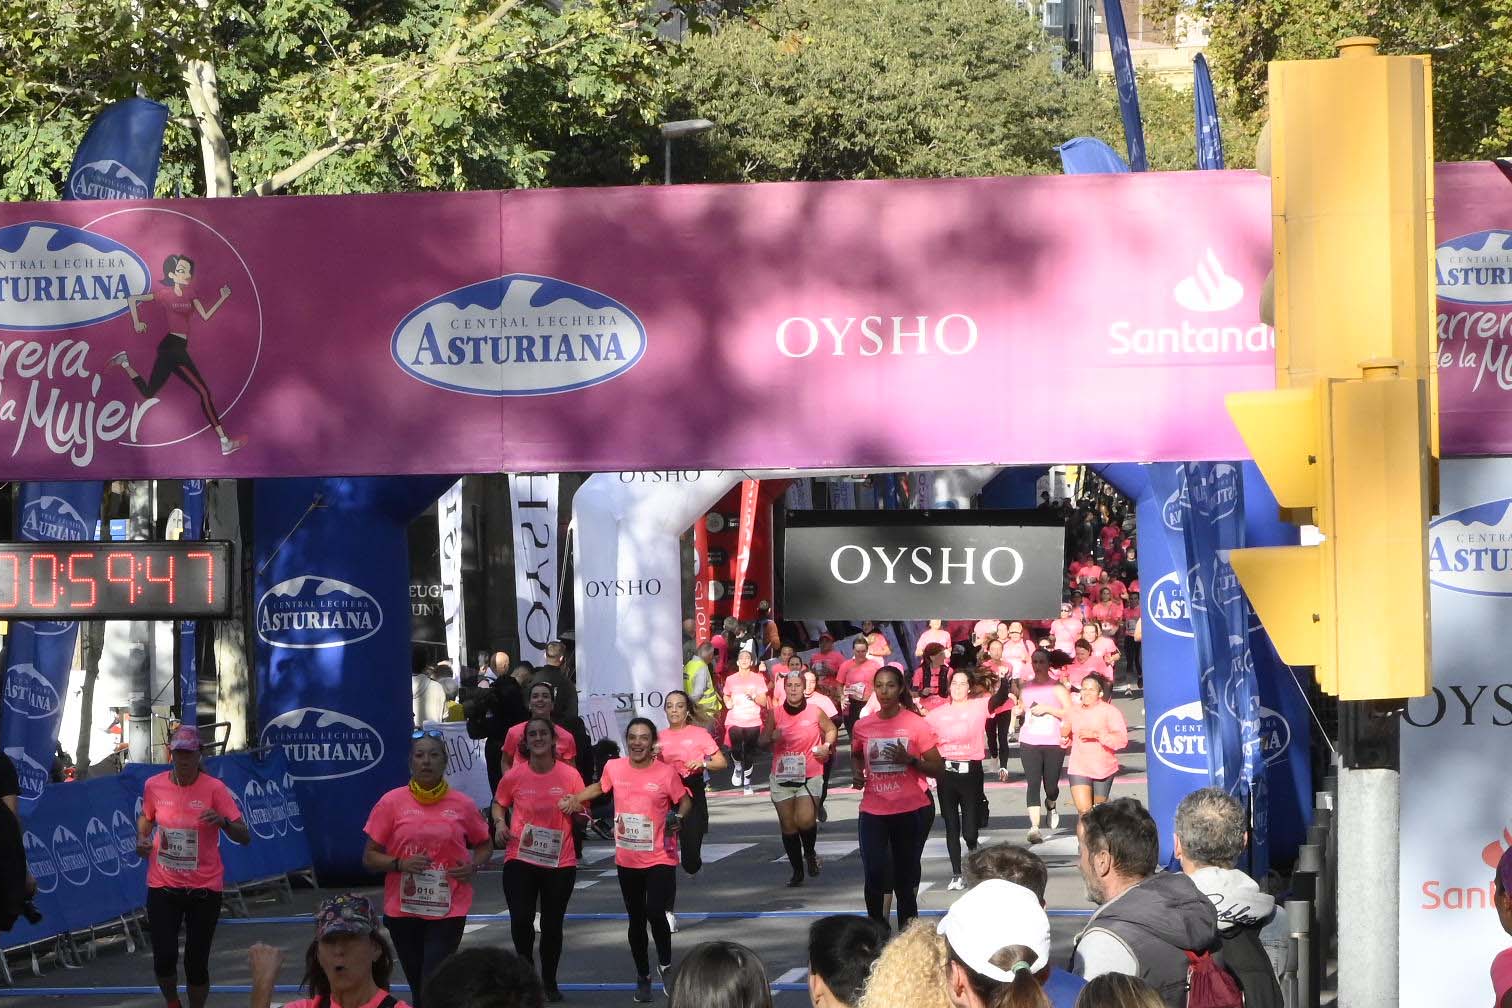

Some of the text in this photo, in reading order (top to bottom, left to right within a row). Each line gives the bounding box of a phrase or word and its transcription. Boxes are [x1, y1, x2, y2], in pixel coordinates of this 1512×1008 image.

[54, 257, 126, 269] LECHERA
[450, 314, 617, 330] CENTRAL LECHERA
[411, 321, 626, 366] ASTURIANA
[775, 314, 978, 359] OYSHO
[1458, 340, 1477, 368] la
[12, 373, 160, 467] Mujer
[619, 470, 702, 484] OYSHO
[830, 544, 1024, 586] OYSHO
[585, 578, 662, 598] OYSHO
[260, 605, 374, 632] ASTURIANA
[616, 691, 663, 710] SHO
